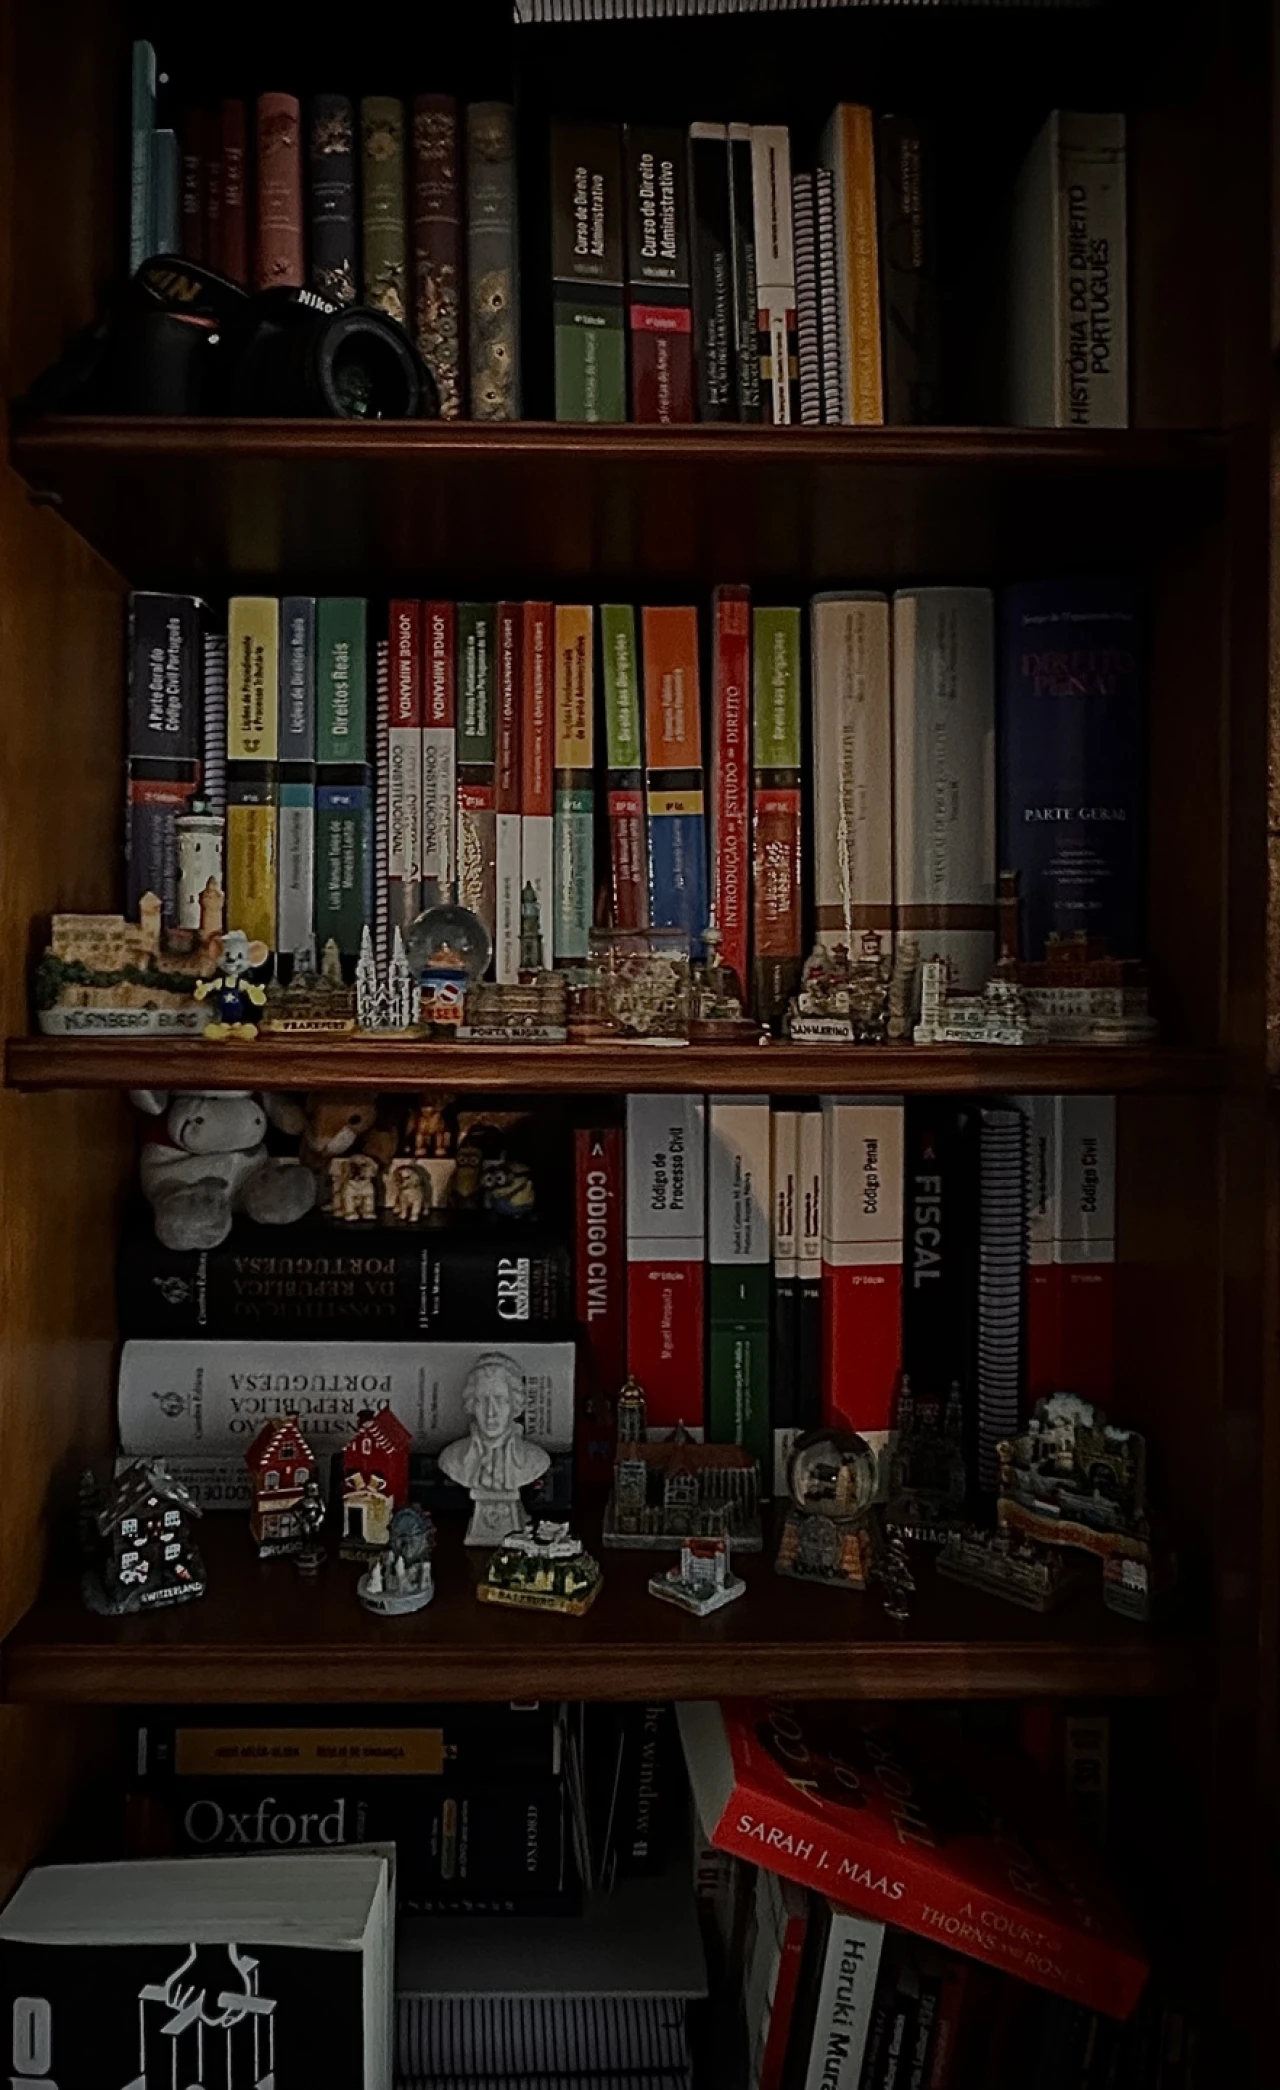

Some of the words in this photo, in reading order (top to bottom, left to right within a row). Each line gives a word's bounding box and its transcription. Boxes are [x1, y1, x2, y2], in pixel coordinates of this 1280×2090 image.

[573, 167, 588, 204] Direito
[637, 153, 654, 198] Direito
[573, 206, 588, 219] de
[590, 174, 605, 256] Administrativo
[639, 200, 655, 216] de
[657, 160, 676, 258] Administrativo
[1065, 185, 1089, 271] DIREITO
[573, 221, 588, 254] Curso
[640, 218, 656, 257] Curso
[1065, 279, 1089, 313] DO
[1089, 239, 1110, 376] PORTUGUÊS
[1065, 324, 1089, 425] HISTÓRIA
[165, 616, 184, 672] Português
[397, 614, 413, 657] JORGE
[432, 614, 447, 658] JORGE
[150, 662, 166, 690] Geral
[331, 641, 350, 679] Reais
[150, 692, 166, 720] Parte
[165, 673, 184, 696] Civil
[397, 659, 413, 719] MIRANDA
[432, 659, 447, 720] MIRANDA
[165, 697, 184, 731] Código
[331, 681, 350, 735] Direitos
[722, 684, 743, 743] DIREITO
[392, 745, 404, 855] CONSTITUCIONAL
[426, 745, 438, 856] CONSTITUCIONAL
[723, 761, 743, 817] ESTUDO
[1024, 807, 1076, 822] PARTE
[722, 834, 745, 927] INTRODUÇÃO
[651, 1152, 669, 1168] de
[669, 1126, 686, 1152] Civil
[863, 1138, 884, 1172] Penal
[1081, 1137, 1100, 1166] Civil
[651, 1168, 669, 1210] Código
[669, 1154, 686, 1210] Processo
[863, 1174, 884, 1214] Código
[1081, 1168, 1100, 1212] Código
[586, 1171, 614, 1257] CÓDIGO
[914, 1175, 942, 1289] FISCAL
[231, 1255, 396, 1277] PORTUGUESA
[231, 1279, 355, 1301] REPÚBLICA
[363, 1279, 396, 1299] DA
[496, 1257, 519, 1320] CRP
[586, 1262, 608, 1322] CIVIL
[229, 1373, 392, 1394] PORTUGUESA
[229, 1397, 354, 1419] REPÚBLICA
[635, 1741, 660, 1834] window
[183, 1796, 347, 1845] Oxford
[525, 1804, 540, 1873] OXFORD
[736, 1814, 815, 1862] SARAH
[816, 1849, 831, 1871] J.
[836, 1858, 908, 1900] MAAS
[920, 1904, 999, 1956] THORNS
[979, 1910, 1048, 1946] COURT
[831, 1938, 867, 2028] Haruki
